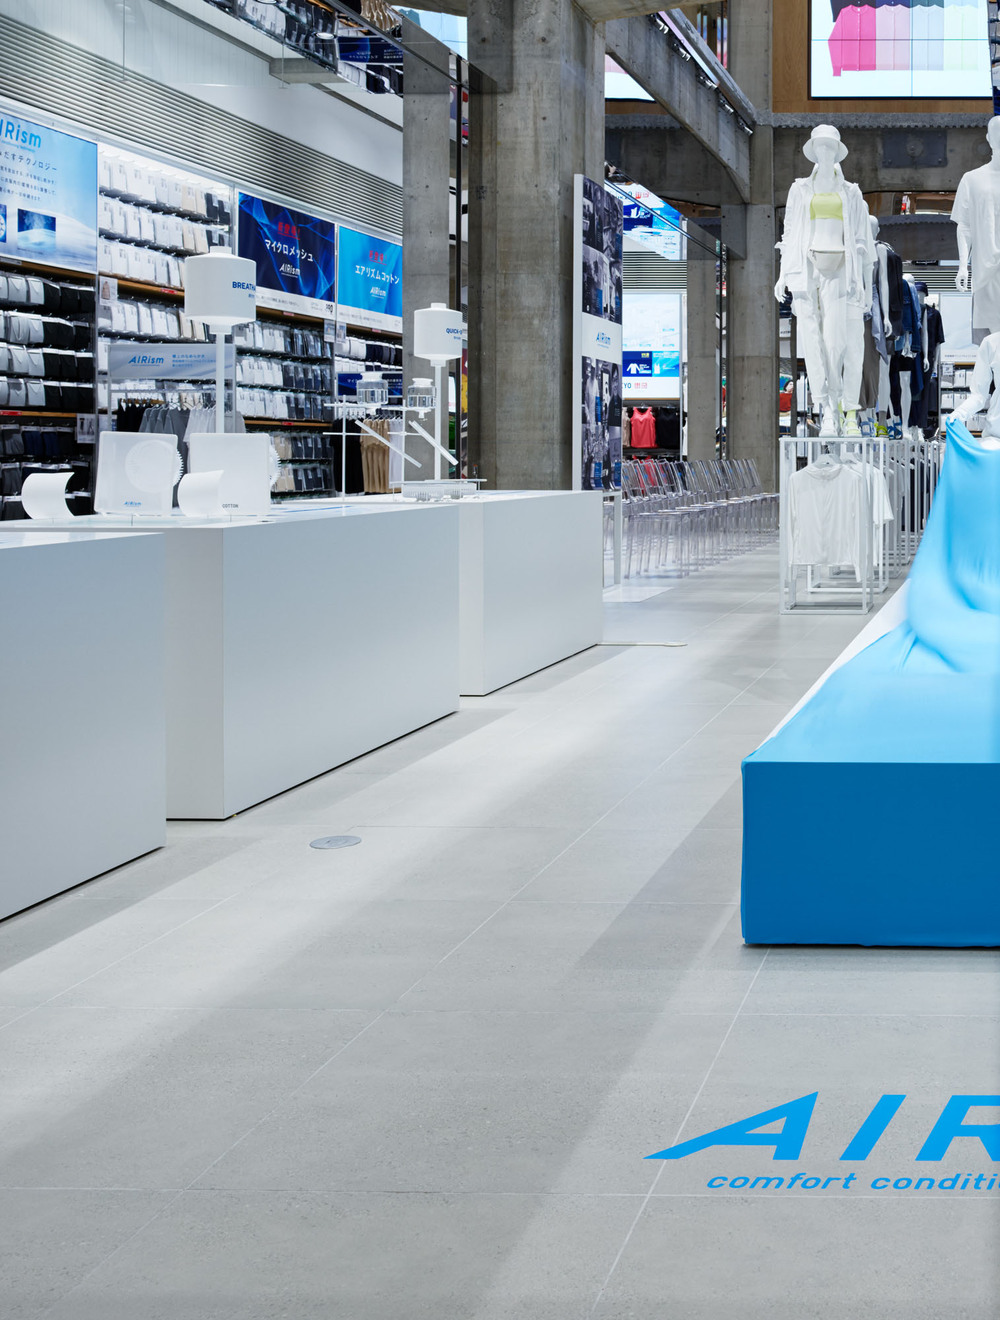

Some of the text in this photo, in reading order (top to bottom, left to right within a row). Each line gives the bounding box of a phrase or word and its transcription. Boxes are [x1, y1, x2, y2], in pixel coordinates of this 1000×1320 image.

[0, 150, 57, 171] だすテクノロジー
[264, 239, 314, 262] マイクロメッシュ
[354, 264, 400, 285] エアリズムコットン
[128, 355, 165, 364] AIRism
[707, 1173, 857, 1189] comfort
